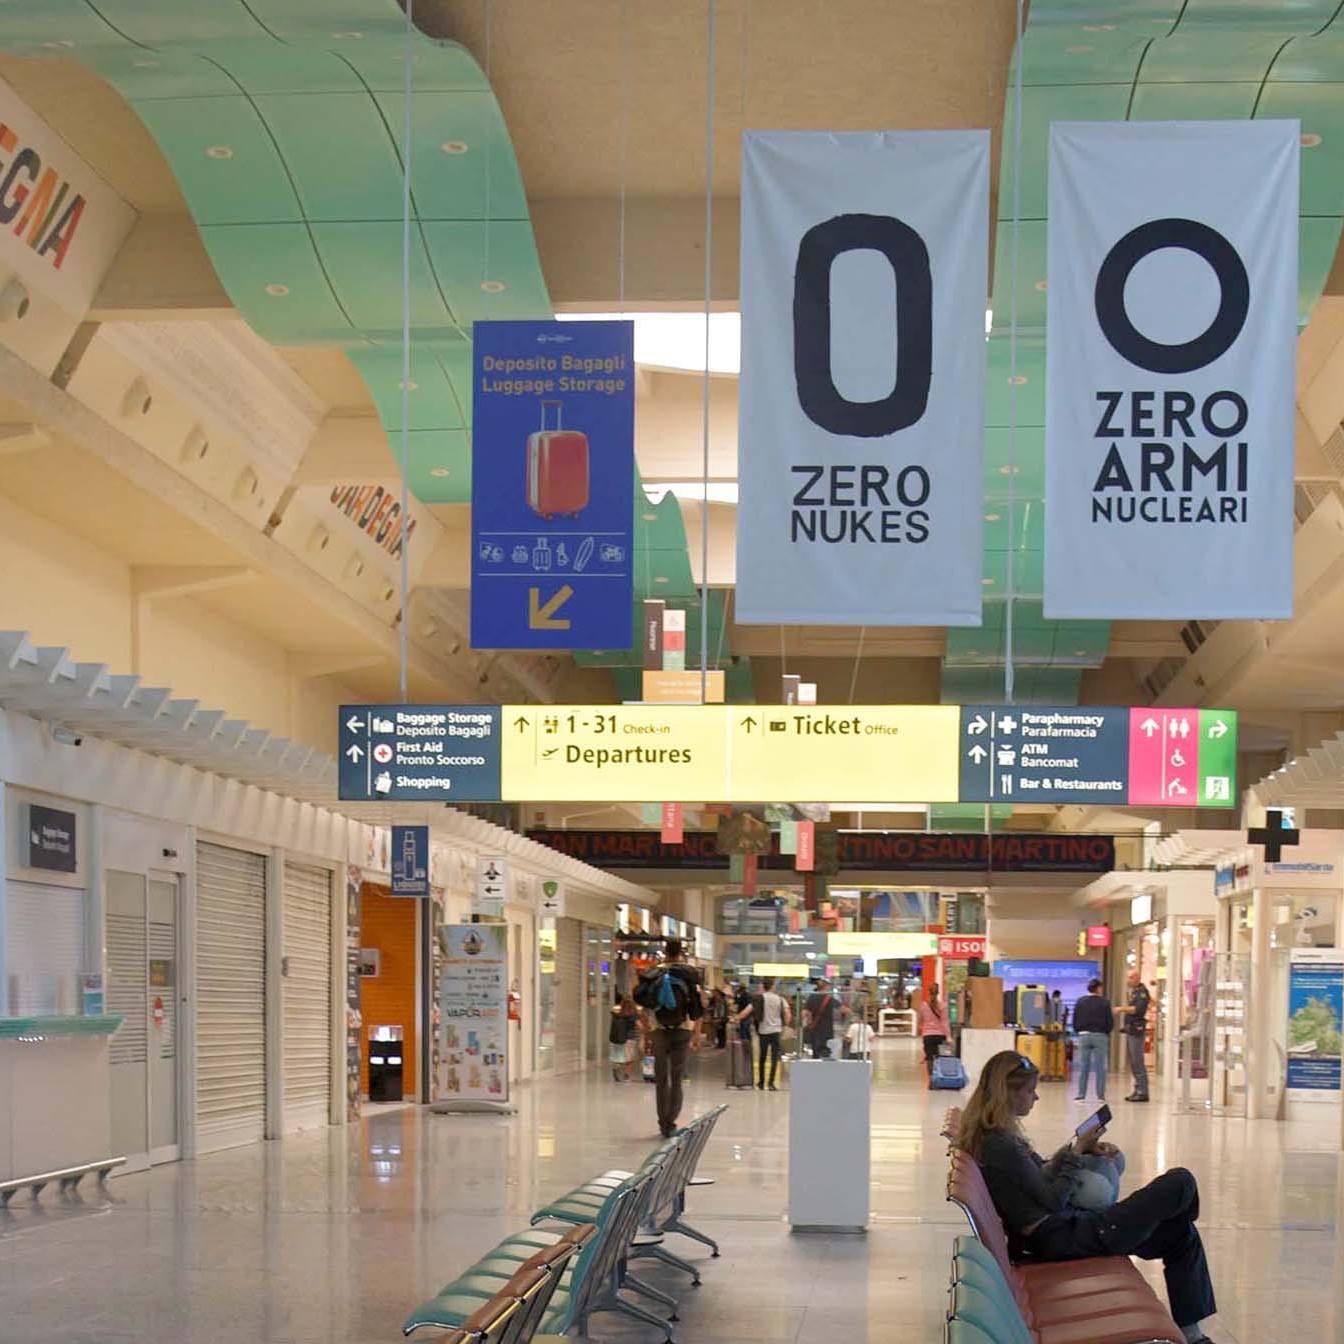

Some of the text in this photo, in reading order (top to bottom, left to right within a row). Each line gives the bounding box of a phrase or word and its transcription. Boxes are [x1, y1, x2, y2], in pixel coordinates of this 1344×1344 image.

[482, 354, 625, 374] Deposito Bagagli
[482, 376, 626, 395] Luggage Storage
[1094, 390, 1249, 438] ZERO
[1092, 442, 1248, 492] ARMI
[790, 465, 931, 507] ZERO
[1092, 497, 1248, 523] NUCLEARI
[790, 510, 930, 543] NUKES
[396, 712, 492, 726] Baggage Storage
[793, 714, 899, 736] Ticket Office
[1021, 712, 1104, 728] Parapharmacy
[396, 724, 491, 739] Deposito Bagagli
[623, 724, 671, 735] Check-in
[1021, 725, 1097, 738] Parafarmacia
[396, 741, 444, 753] First Aid
[1021, 743, 1049, 755] ATM
[396, 754, 486, 766] Pronto Soccorso
[566, 744, 692, 769] Departures
[1021, 756, 1079, 768] Bancomat
[396, 775, 451, 790] Shopping
[1019, 777, 1123, 791] Bar & Restaurants
[983, 837, 1110, 863] MARTINO
